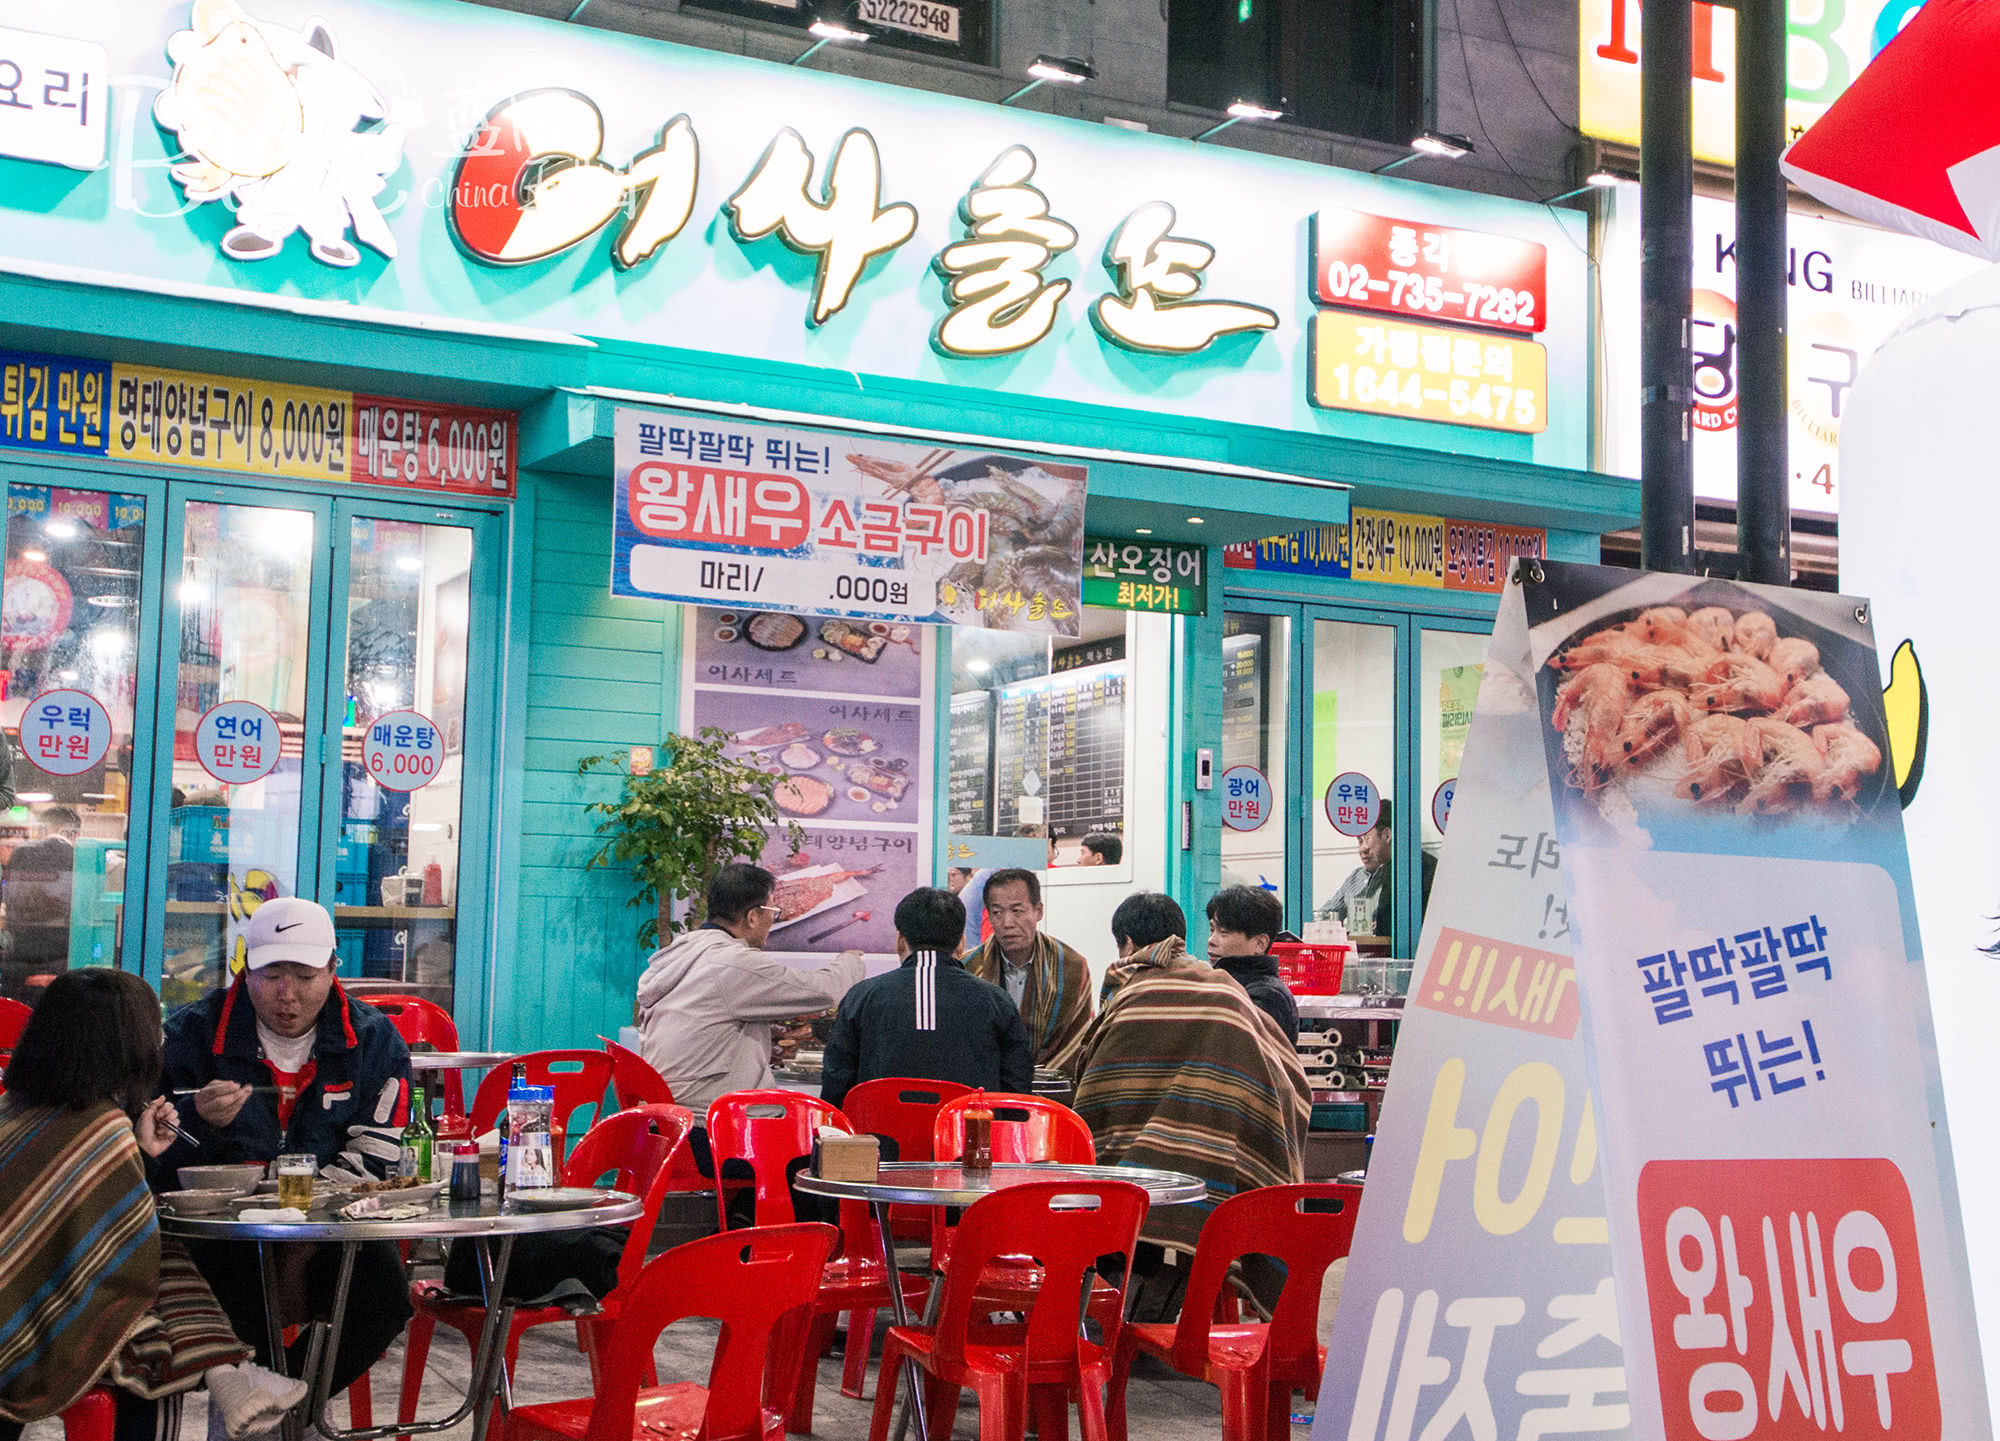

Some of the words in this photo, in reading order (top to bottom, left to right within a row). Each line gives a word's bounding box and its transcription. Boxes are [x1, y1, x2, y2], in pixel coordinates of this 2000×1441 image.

[1328, 260, 1535, 326] 02-735-7282
[1, 362, 49, 442] 튀김
[58, 369, 103, 447] 만원
[1334, 363, 1536, 425] 1644-5475
[117, 375, 254, 465] 명태양념구이
[259, 396, 346, 474] 8,000원
[358, 404, 421, 483] 매운탕
[427, 416, 508, 491] 6,000원
[638, 423, 755, 466] 팔딱팔딱
[765, 439, 830, 475] 뛰는!
[635, 466, 802, 542] 왕새우
[816, 499, 990, 562] 소금구이
[1089, 542, 1201, 586] 산오징어
[1355, 516, 1396, 574] 간장새우
[1398, 523, 1444, 578] 10,000원
[1447, 525, 1496, 584] 오징어튀김
[700, 560, 765, 594] 마리/
[1117, 581, 1179, 610] 최저가!
[708, 665, 798, 684] 어사세트
[39, 705, 91, 732] 우럭
[214, 715, 263, 742] 연어
[828, 705, 914, 723] 어사세트
[38, 734, 90, 761] 만원
[373, 723, 436, 750] 매운탕
[213, 743, 262, 770] 만원
[371, 753, 435, 777] 6,000
[1227, 777, 1260, 798] 광어
[1337, 783, 1369, 805] 우럭
[1228, 799, 1261, 821] 만원
[1337, 805, 1370, 826] 만원
[1636, 914, 1833, 1026] 팔딱팔딱
[1702, 1019, 1826, 1109] 뛰는!
[1664, 1204, 1914, 1441] 왕새우
